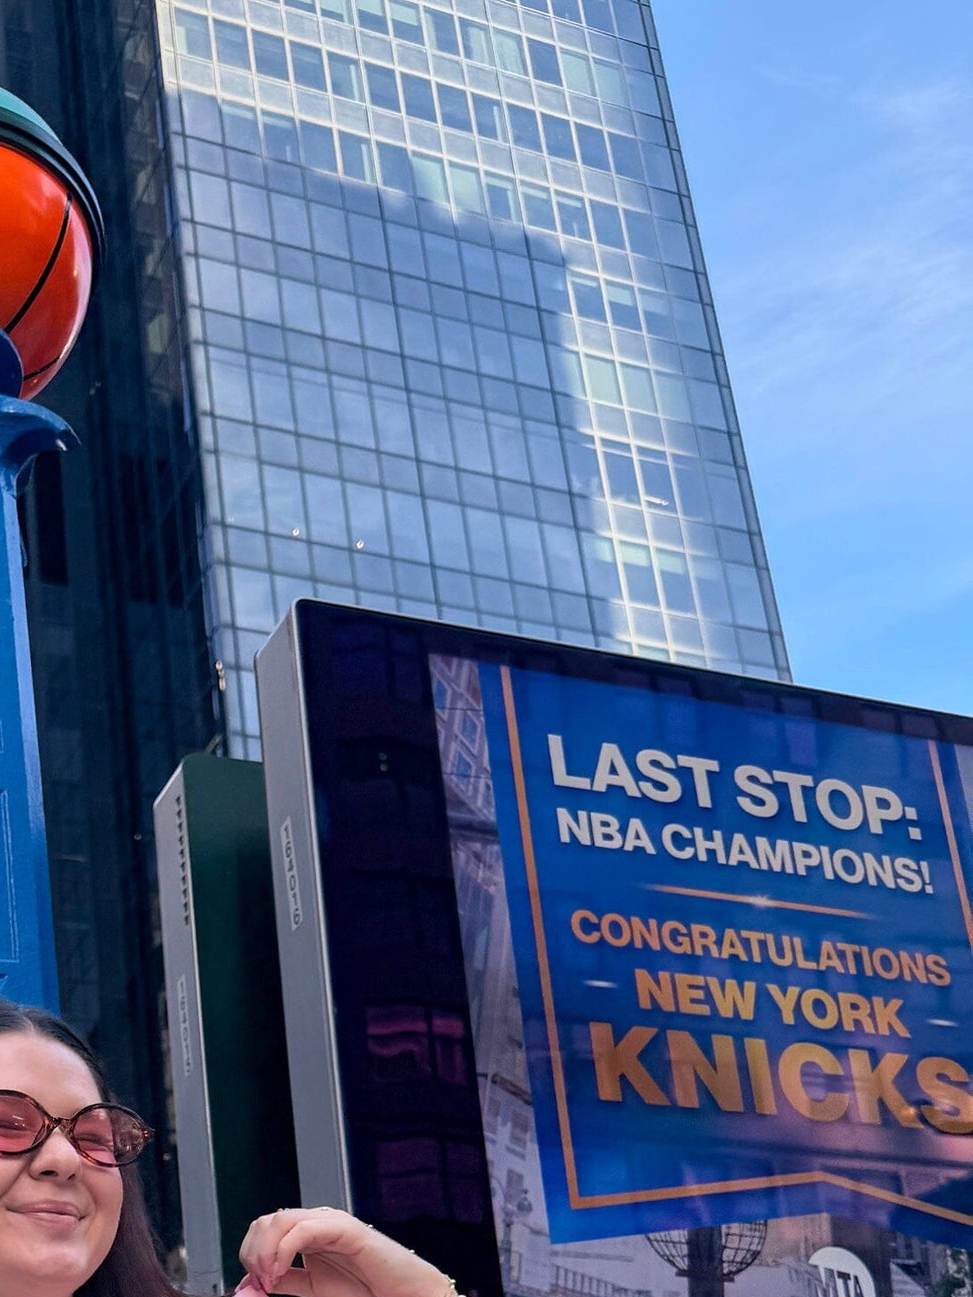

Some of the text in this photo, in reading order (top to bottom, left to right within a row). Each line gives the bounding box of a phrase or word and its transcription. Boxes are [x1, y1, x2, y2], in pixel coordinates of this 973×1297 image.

[547, 734, 922, 841] LAST STOP:
[556, 807, 934, 894] NBA CHAMPIONS!
[571, 908, 952, 987] CONGRATULATIONS
[635, 968, 912, 1039] NEW YORK
[589, 1021, 973, 1136] KNICKS
